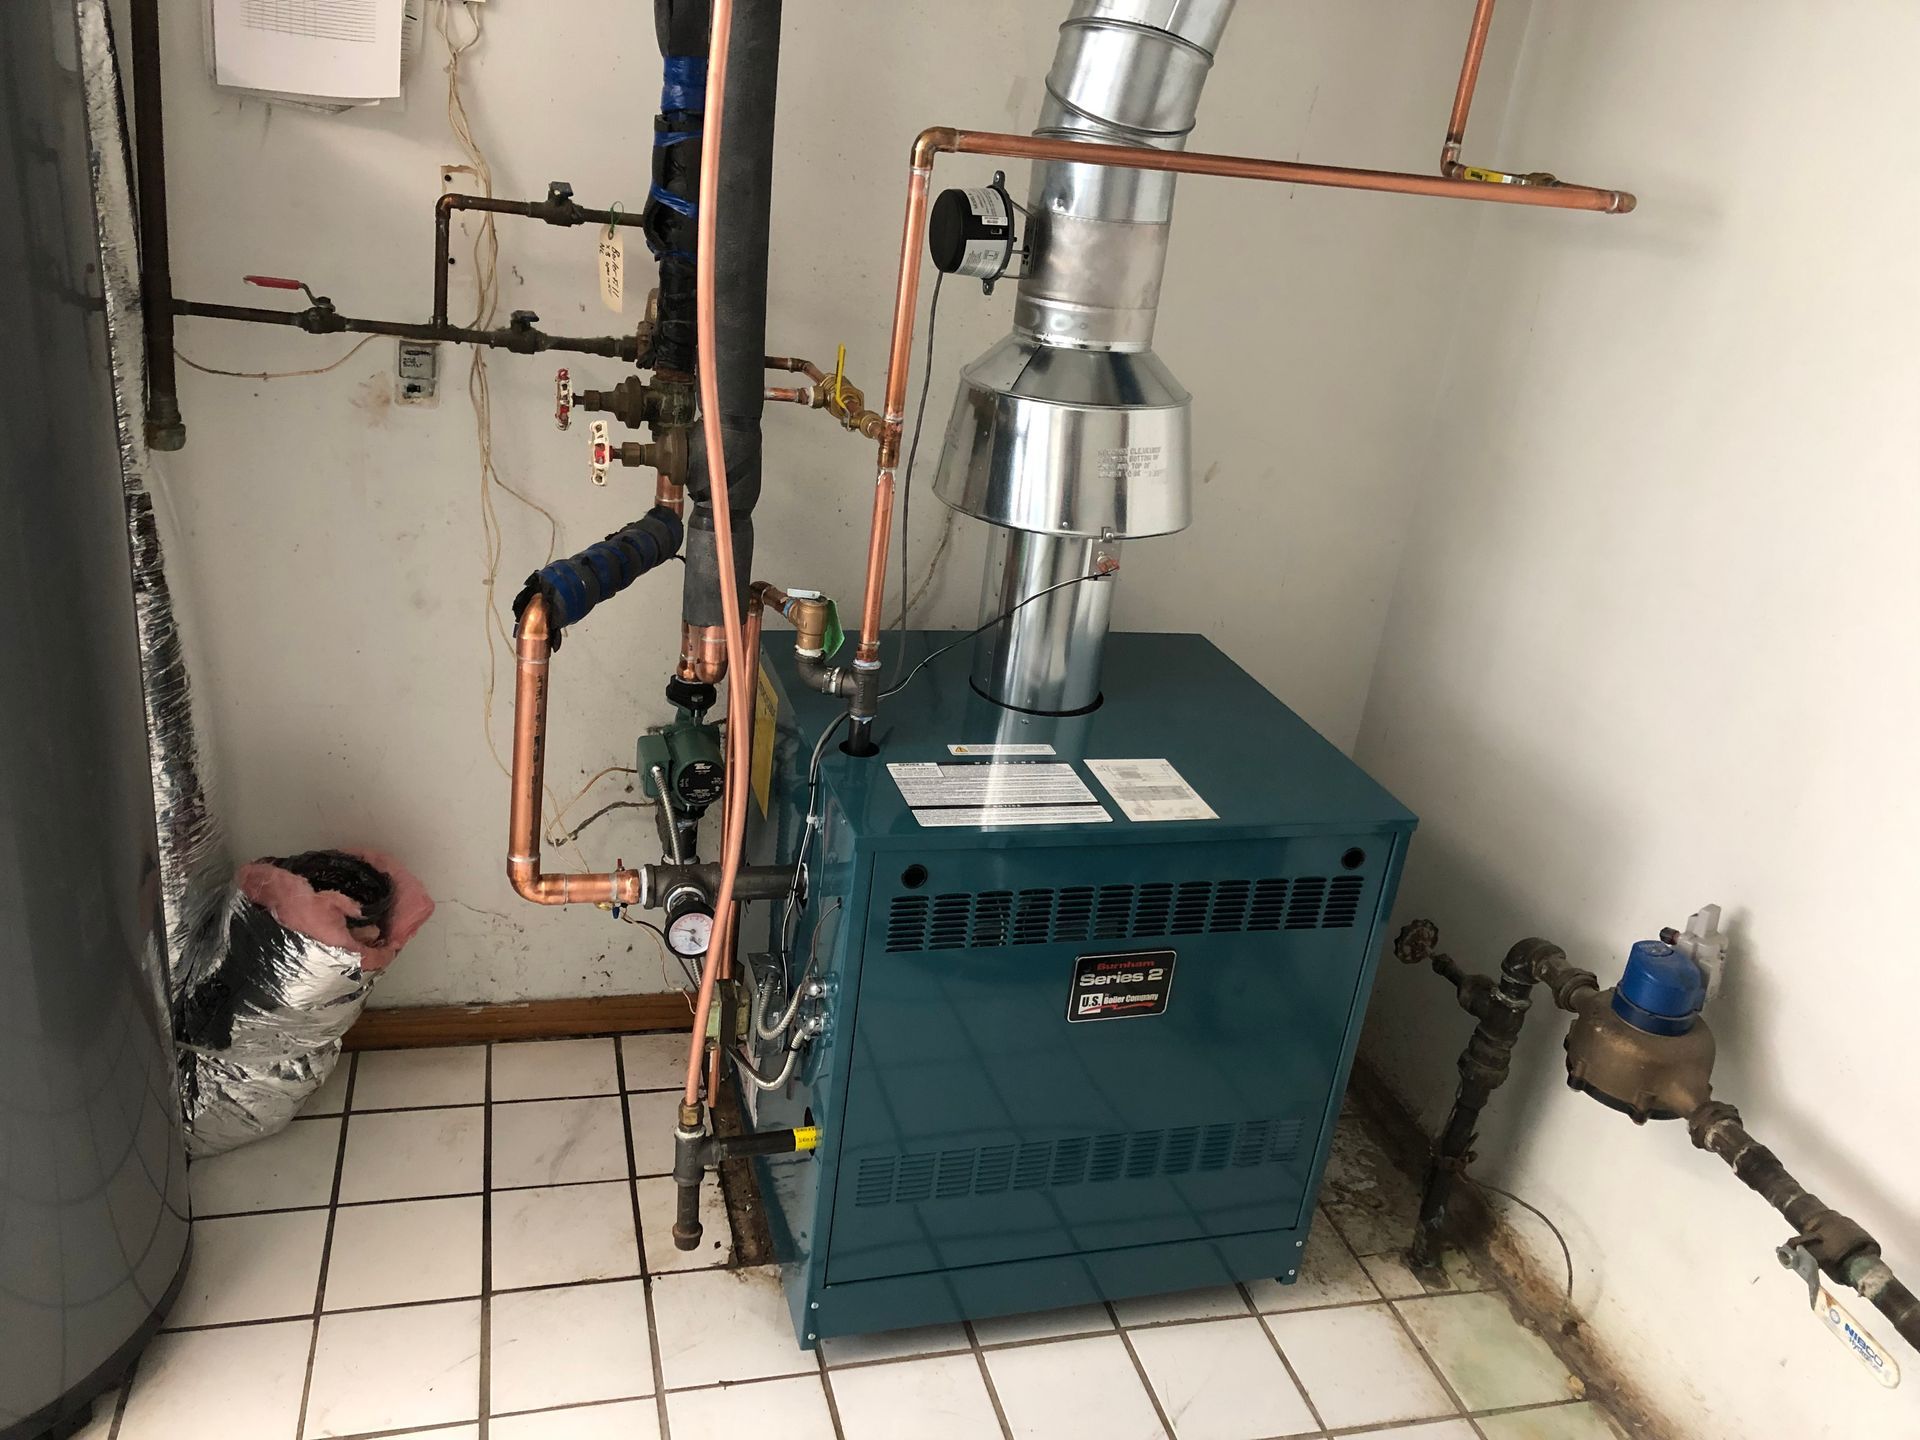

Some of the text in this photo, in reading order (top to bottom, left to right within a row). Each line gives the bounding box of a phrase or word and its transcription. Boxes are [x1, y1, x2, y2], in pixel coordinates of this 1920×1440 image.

[1097, 960, 1155, 971] Burnham
[1079, 968, 1164, 987] Series 2
[1081, 993, 1159, 1008] U.S. Boiler Company
[1845, 1323, 1884, 1368] NIBCO
